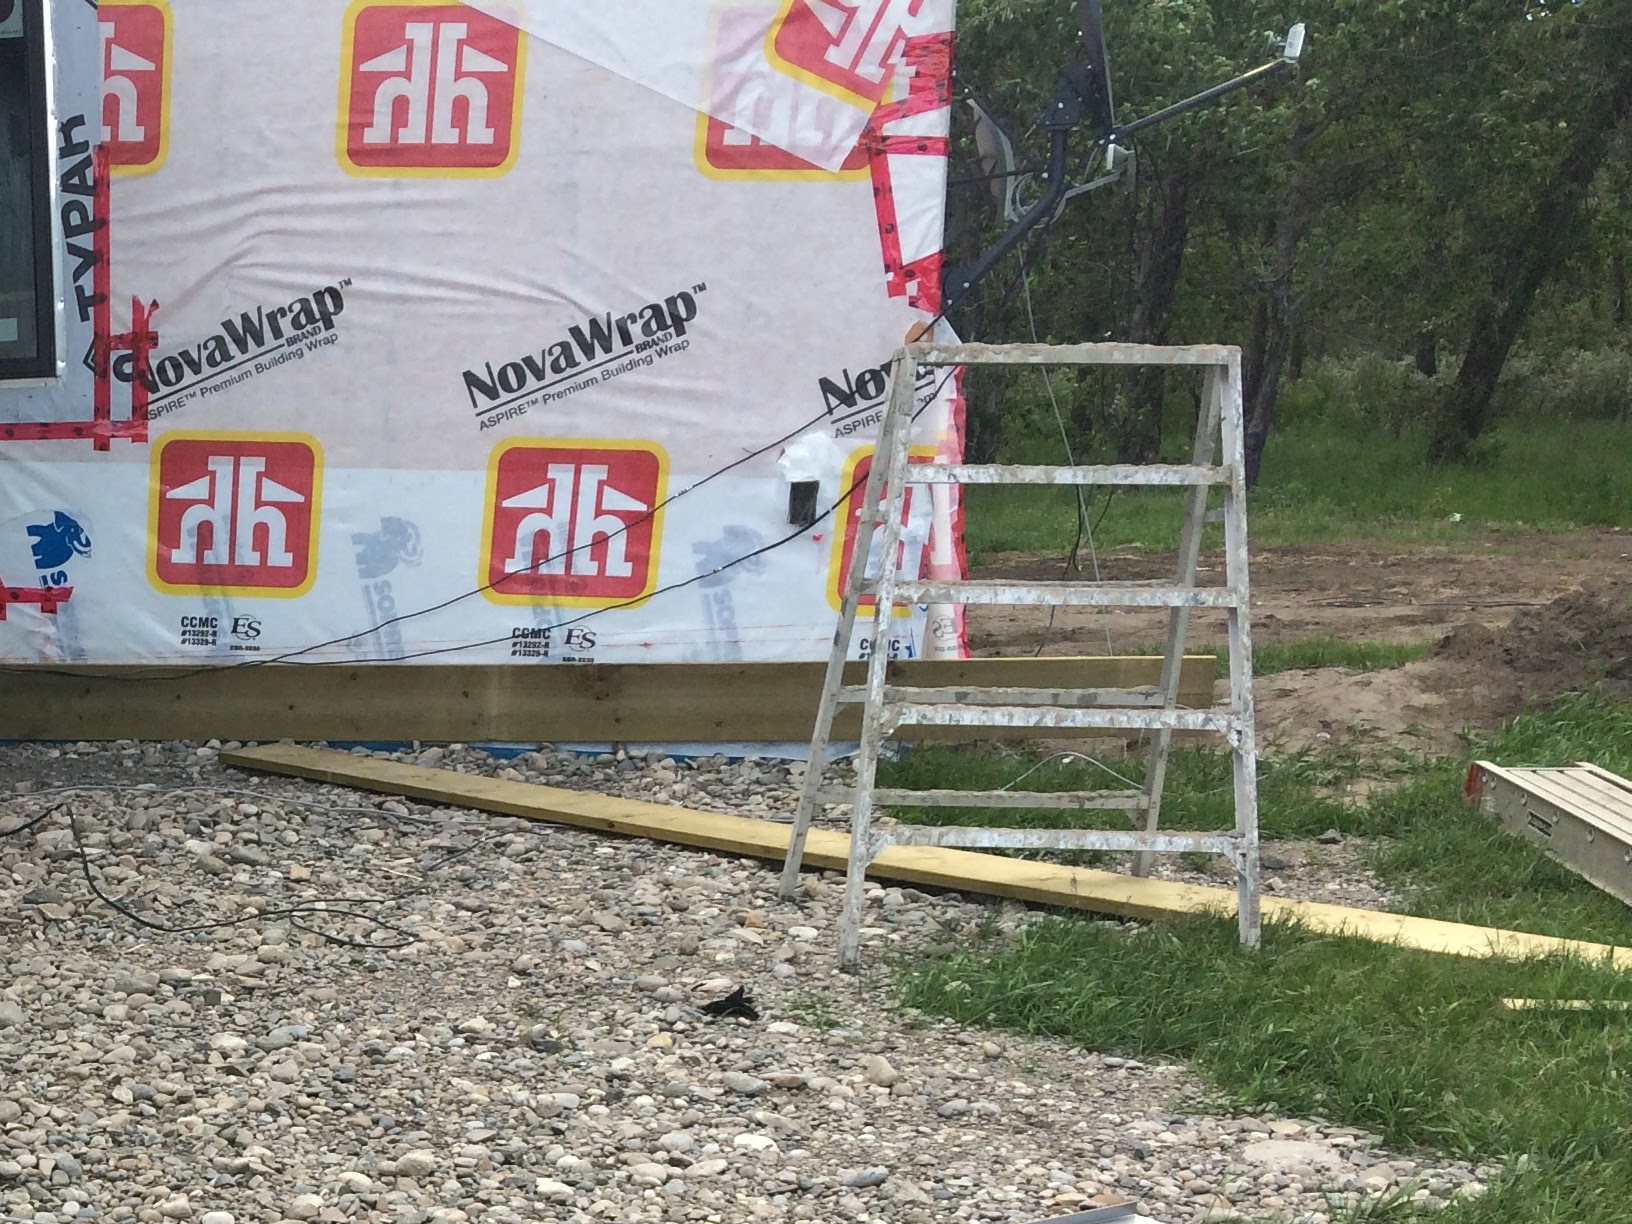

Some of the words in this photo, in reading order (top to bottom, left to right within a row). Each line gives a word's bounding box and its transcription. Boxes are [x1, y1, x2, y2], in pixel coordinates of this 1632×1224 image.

[285, 325, 322, 348] BRAND
[635, 331, 674, 354] BRAND
[200, 368, 254, 399] Premium
[255, 349, 305, 375] Building
[305, 332, 339, 356] Wrap
[542, 376, 599, 406] Premium
[600, 354, 654, 382] Building
[655, 339, 691, 360] Wrap
[180, 615, 219, 629] CCMC
[512, 627, 551, 640] CCMC
